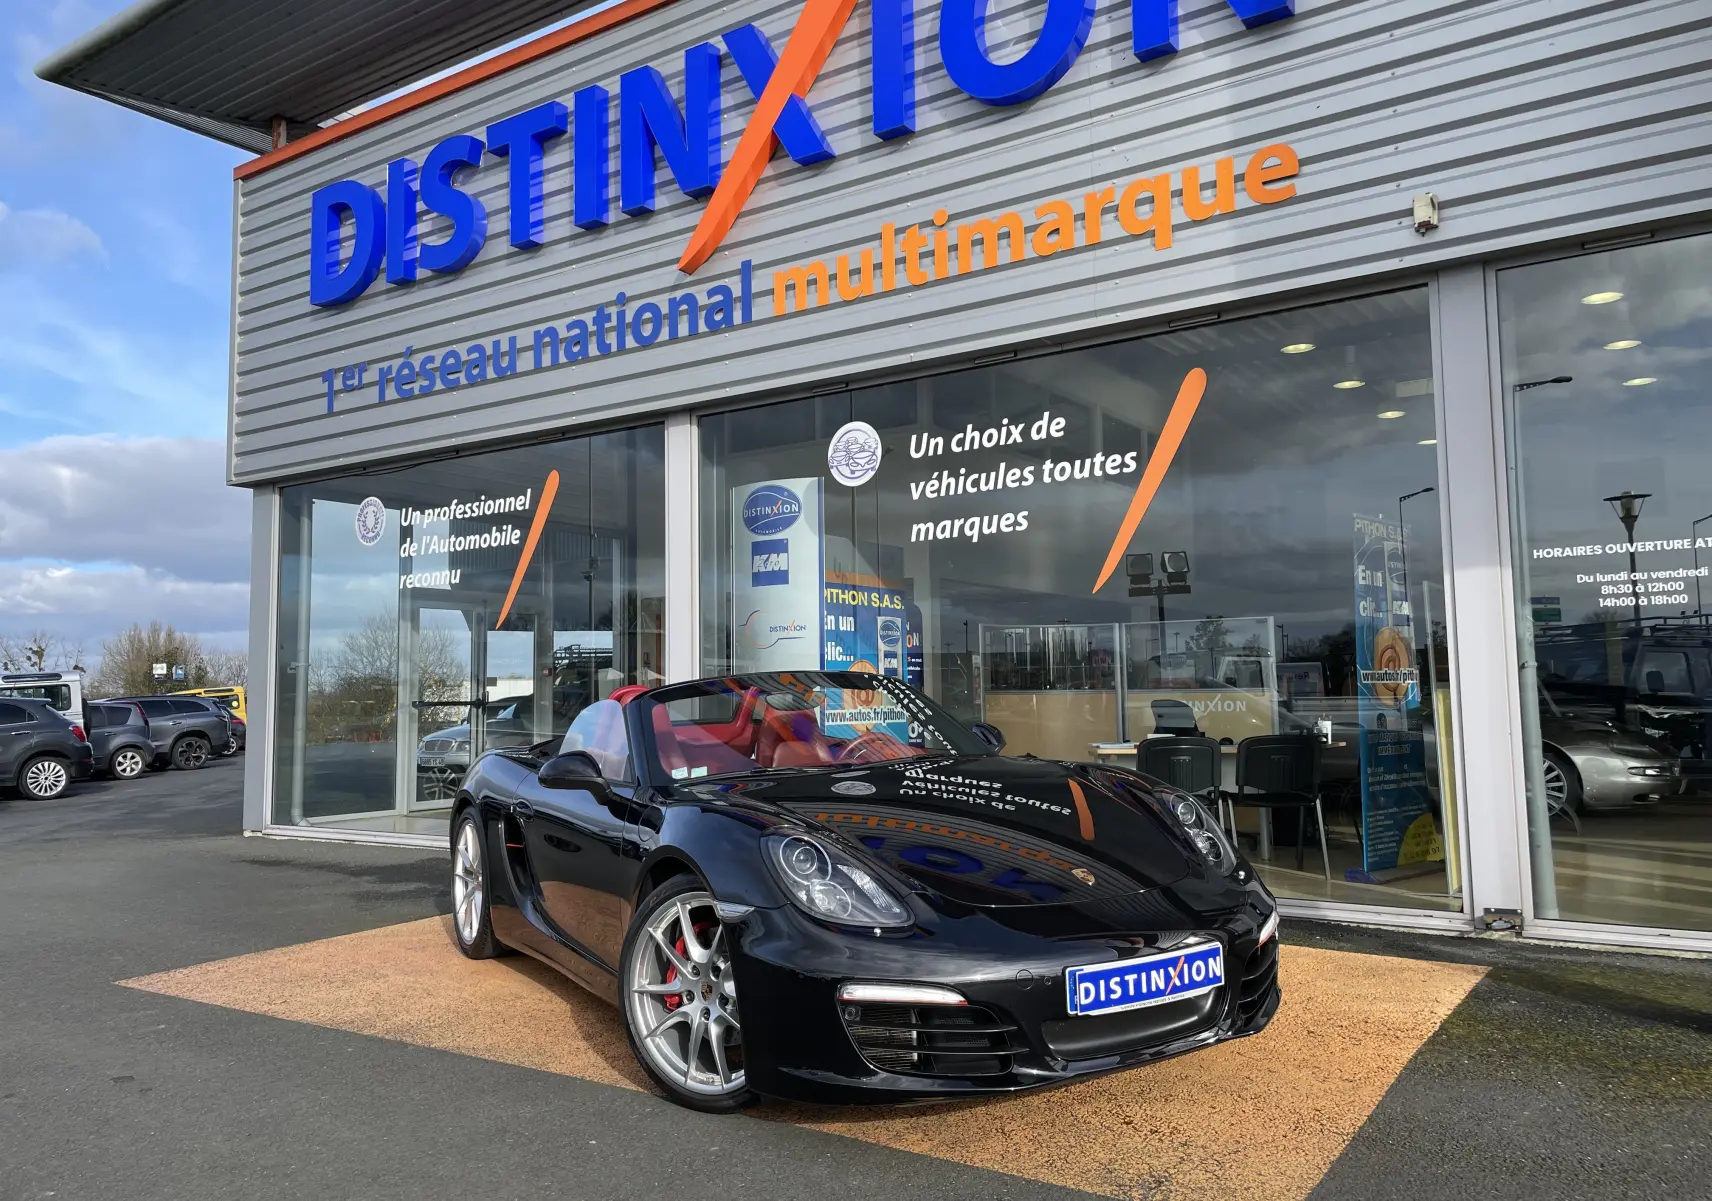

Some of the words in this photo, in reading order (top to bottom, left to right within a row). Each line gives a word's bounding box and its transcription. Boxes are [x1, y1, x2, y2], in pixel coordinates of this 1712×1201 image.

[321, 361, 367, 413] 1er
[378, 336, 518, 402] réseau
[533, 260, 753, 372] national
[773, 143, 1300, 317] multimarque
[909, 432, 944, 459] Un
[950, 417, 1026, 453] choix
[1030, 411, 1066, 441] de
[910, 462, 1035, 500] véhicules
[1042, 451, 1138, 484] toutes
[401, 507, 420, 527] Un
[423, 489, 532, 529] professionnel
[744, 500, 799, 518] DISTINXION
[910, 510, 1029, 543] marques
[400, 538, 418, 557] de
[421, 525, 522, 556] l'Automobile
[1533, 545, 1603, 559] HORAIRES
[1605, 538, 1692, 554] OUVERTURE
[1694, 537, 1712, 549] AT
[400, 567, 461, 589] reconnu
[1576, 574, 1594, 583] Du
[1596, 571, 1628, 582] lundi
[1630, 572, 1648, 580] au
[1650, 566, 1709, 579] vendredi
[1601, 584, 1633, 595] 8h30
[1635, 583, 1645, 593] à
[1647, 581, 1685, 593] 12h00
[870, 592, 905, 610] S.A.S.
[1599, 597, 1636, 607] 14h00
[1638, 595, 1648, 606] à
[1650, 594, 1689, 606] 18h00
[770, 620, 807, 635] DISTINXION
[838, 615, 855, 632] un
[1079, 955, 1222, 1005] DISTINXION
